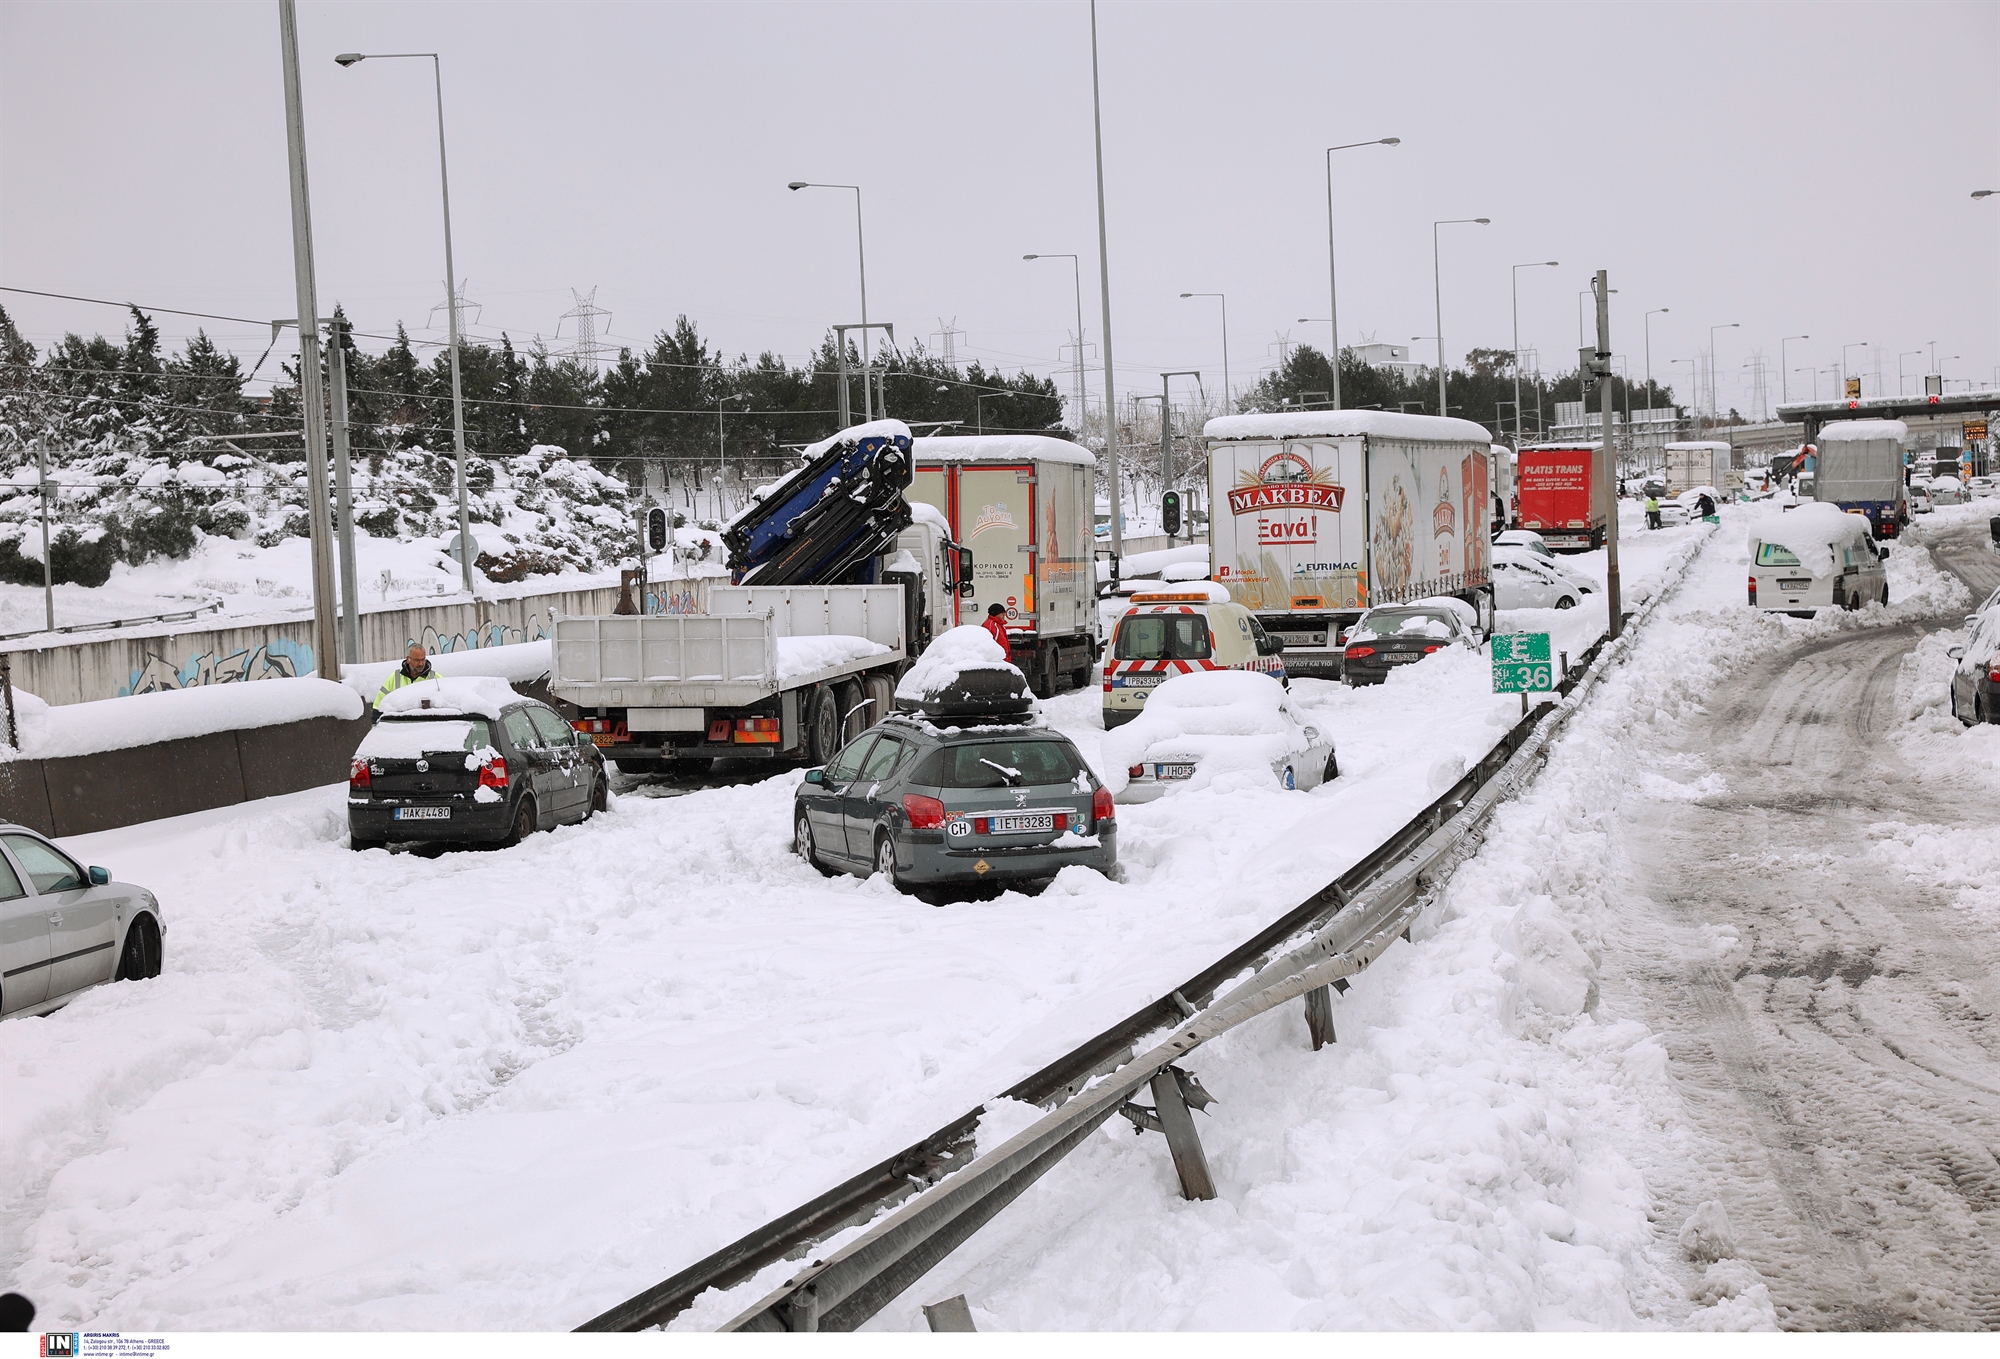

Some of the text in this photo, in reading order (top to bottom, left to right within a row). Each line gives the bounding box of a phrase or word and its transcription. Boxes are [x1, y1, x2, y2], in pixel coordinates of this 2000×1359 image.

[1524, 465, 1583, 475] PLATIS TRANS
[1231, 488, 1339, 511] ΜΑΚΒΕΛ
[1258, 515, 1318, 538] Ξανά!
[1306, 562, 1358, 571] EURIMAC
[1510, 636, 1530, 659] E
[1516, 666, 1550, 689] 36
[1495, 680, 1514, 689] Km
[951, 822, 967, 835] CH
[1077, 825, 1083, 833] F
